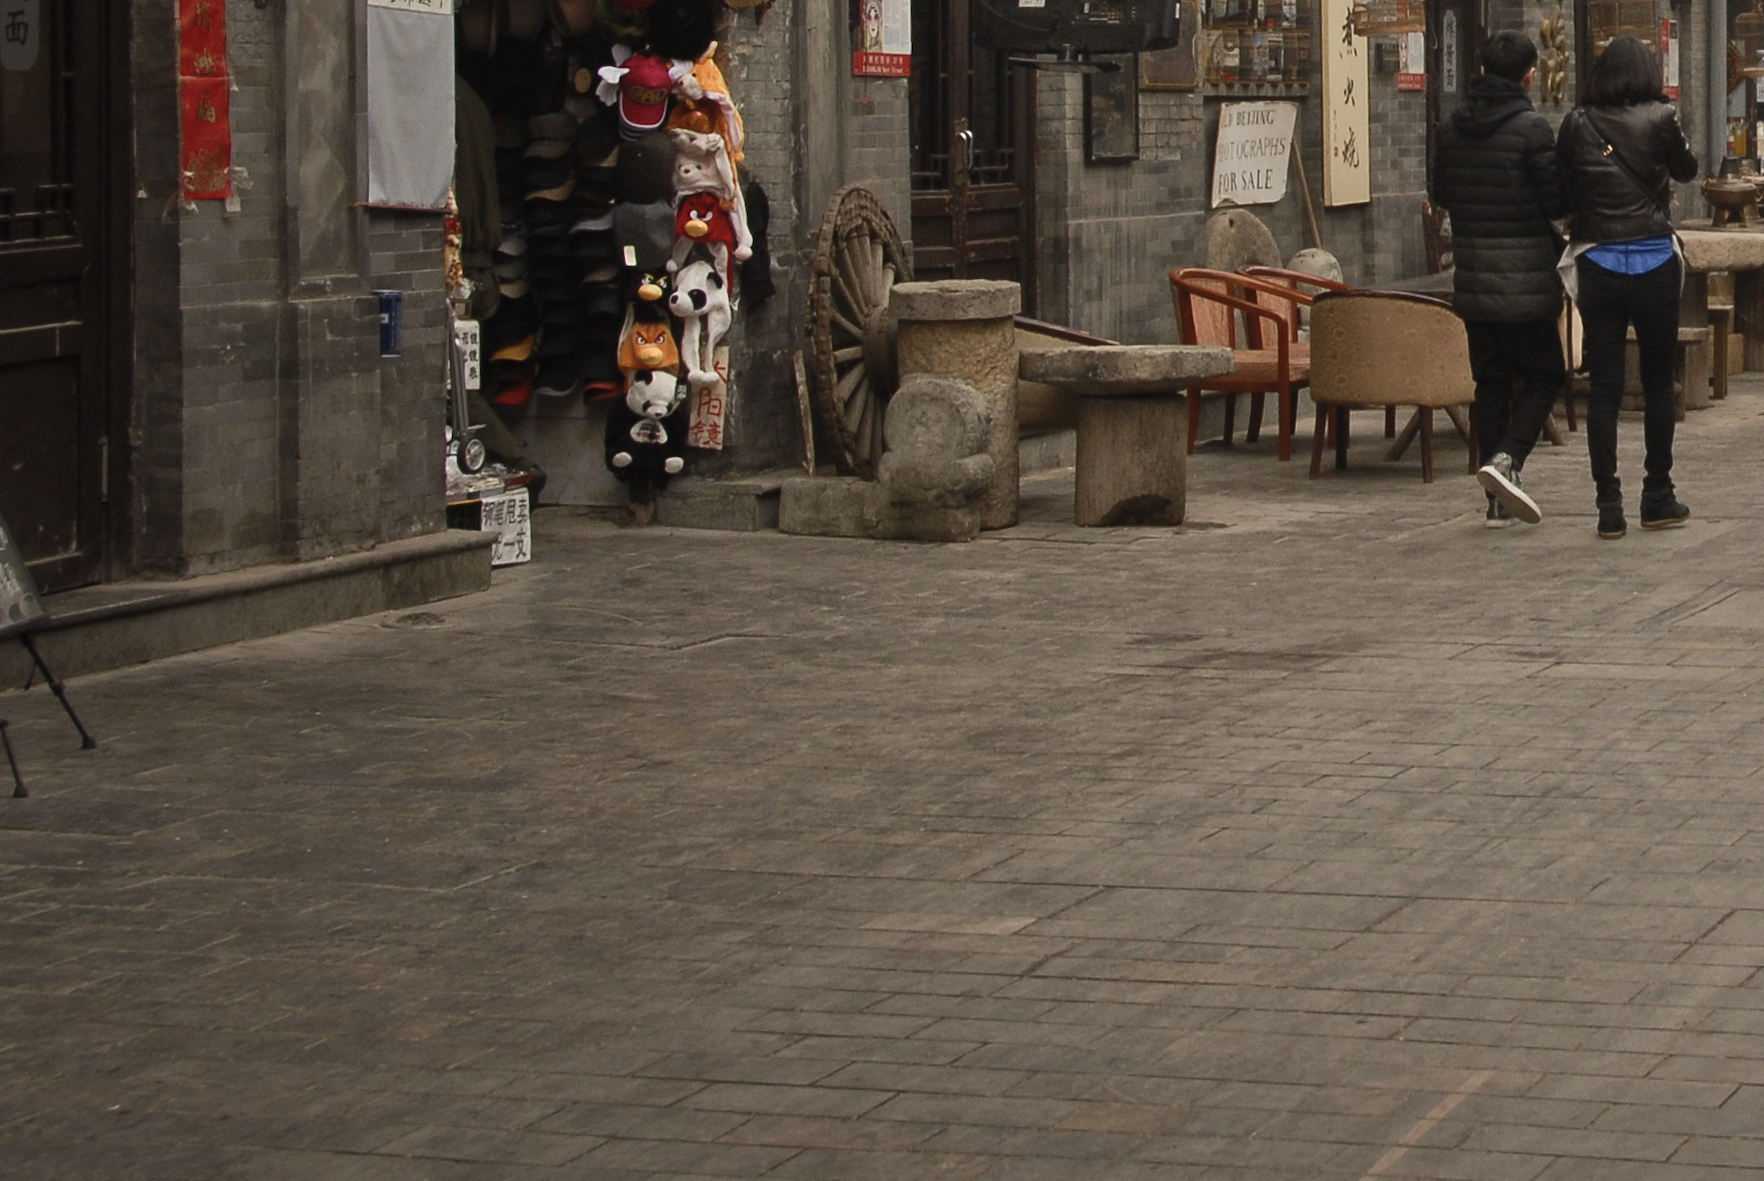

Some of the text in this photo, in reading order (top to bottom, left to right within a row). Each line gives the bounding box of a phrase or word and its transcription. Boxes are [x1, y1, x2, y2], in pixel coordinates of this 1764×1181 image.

[1236, 109, 1276, 126] BEIJING
[1218, 169, 1273, 195] FOR SALE
